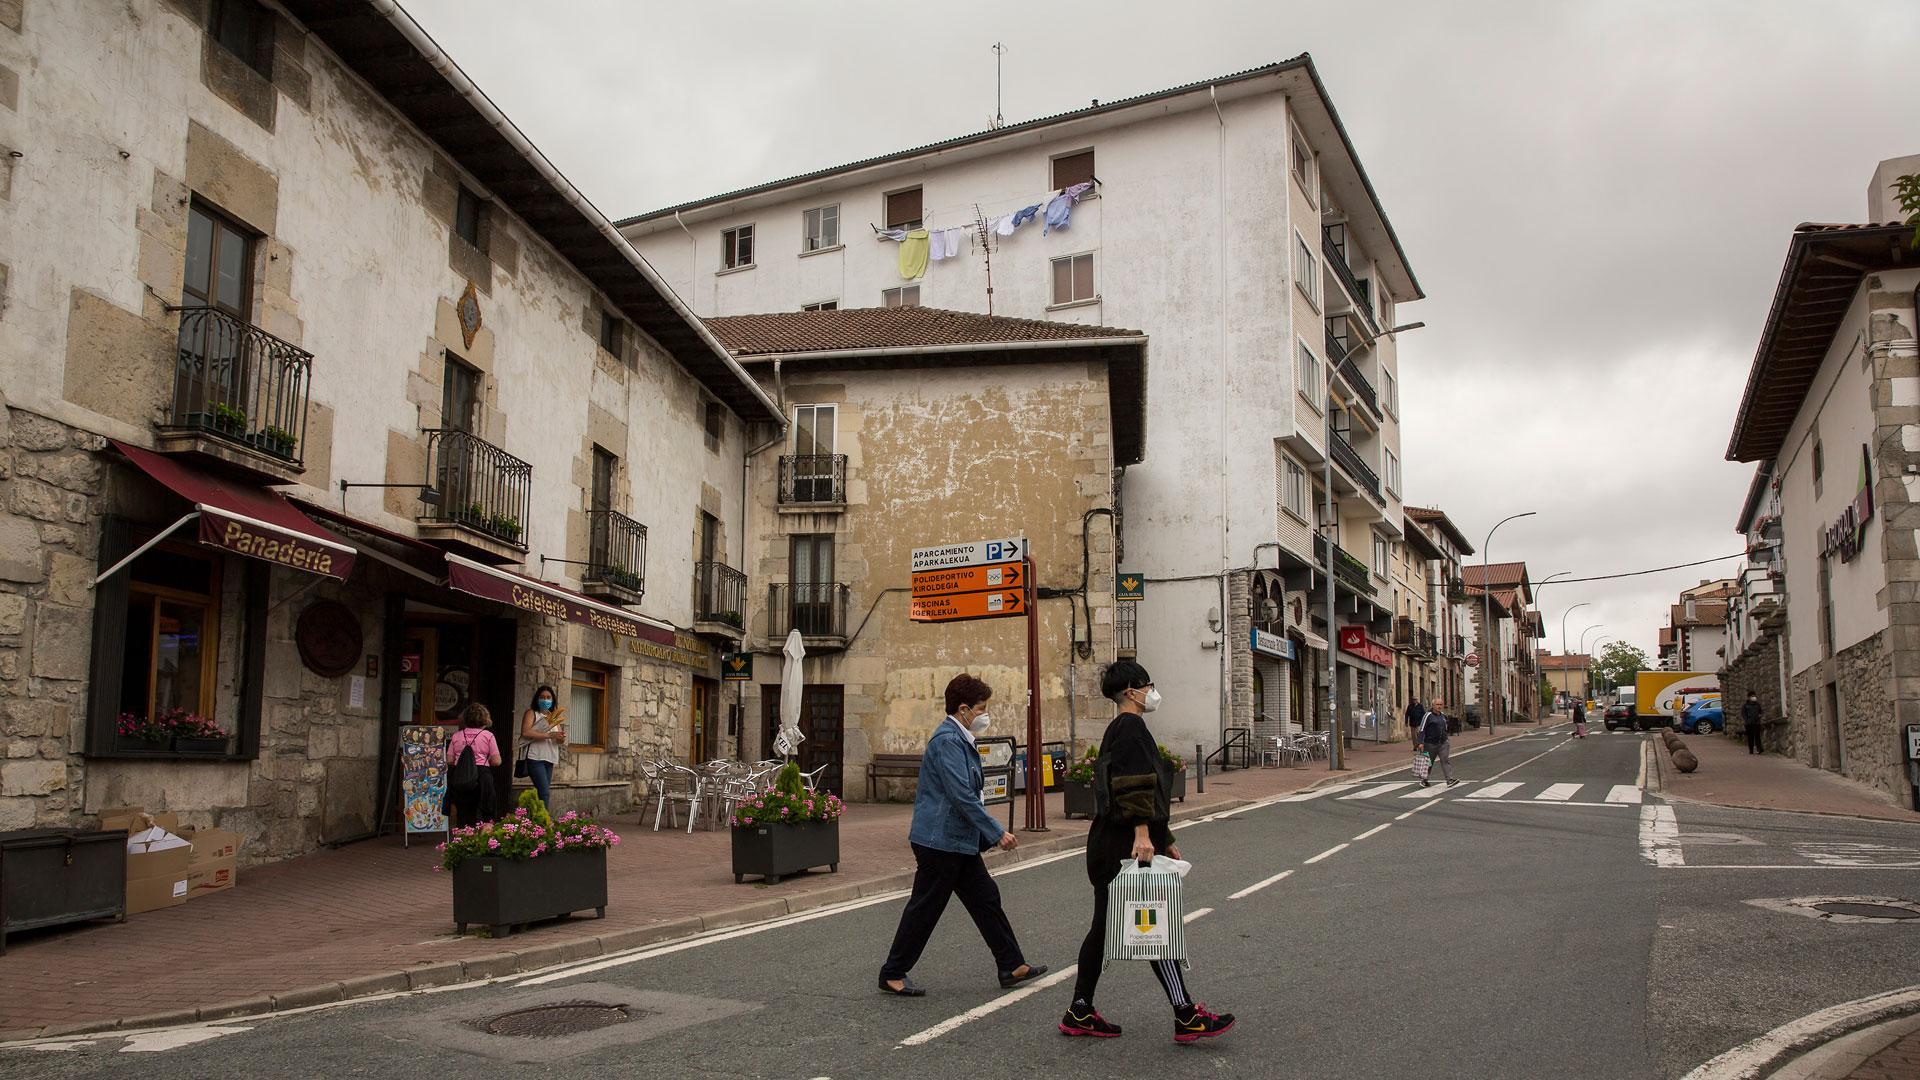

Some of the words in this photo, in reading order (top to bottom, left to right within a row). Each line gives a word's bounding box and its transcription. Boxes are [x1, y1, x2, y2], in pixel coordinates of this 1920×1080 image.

[224, 521, 332, 573] Panadería
[913, 545, 975, 559] APARCAMIENTO
[913, 555, 970, 568] APARKALEKUA
[913, 571, 975, 584] POLIDEPORTIVO
[913, 582, 959, 593] KIROLDEGIA
[512, 584, 568, 620] Cafetería
[913, 599, 951, 609] PISCINAS
[912, 608, 958, 617] IGERILEKUA
